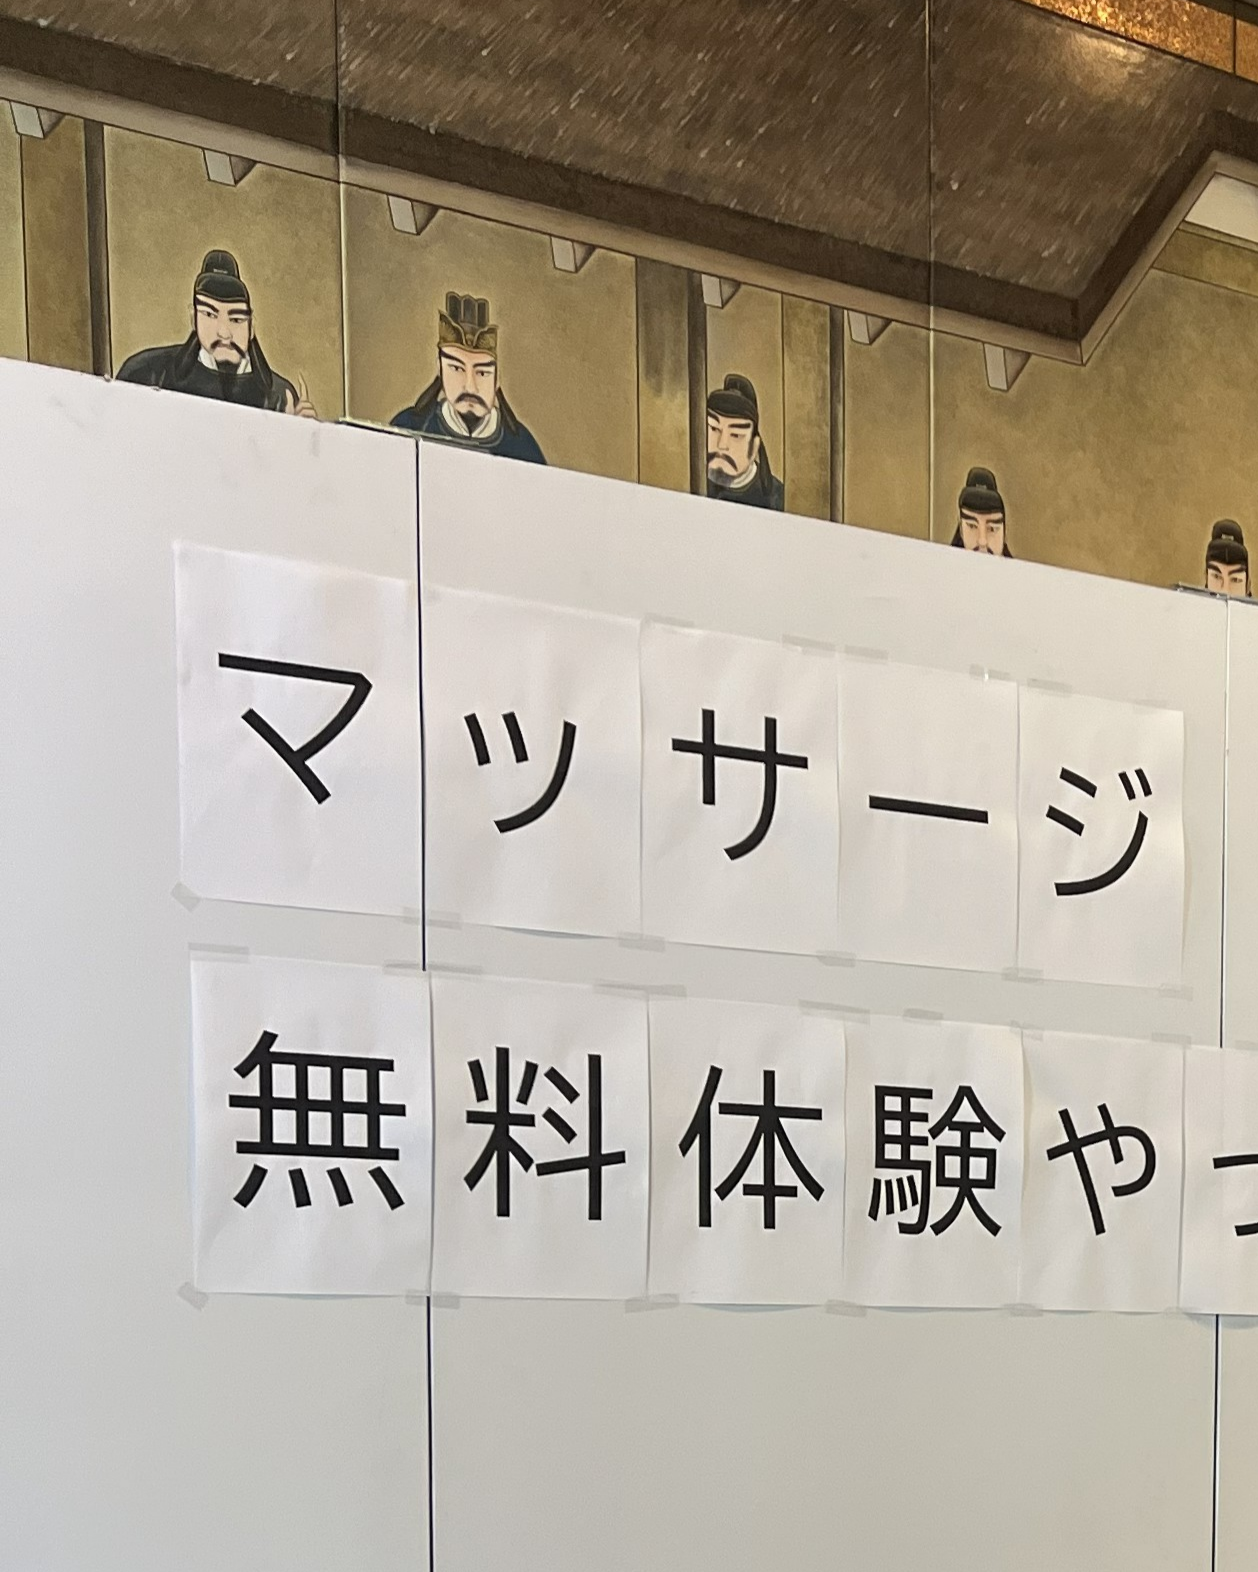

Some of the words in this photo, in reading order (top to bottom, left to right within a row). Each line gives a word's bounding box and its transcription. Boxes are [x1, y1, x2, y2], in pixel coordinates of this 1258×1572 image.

[218, 652, 1153, 896] マッサージ
